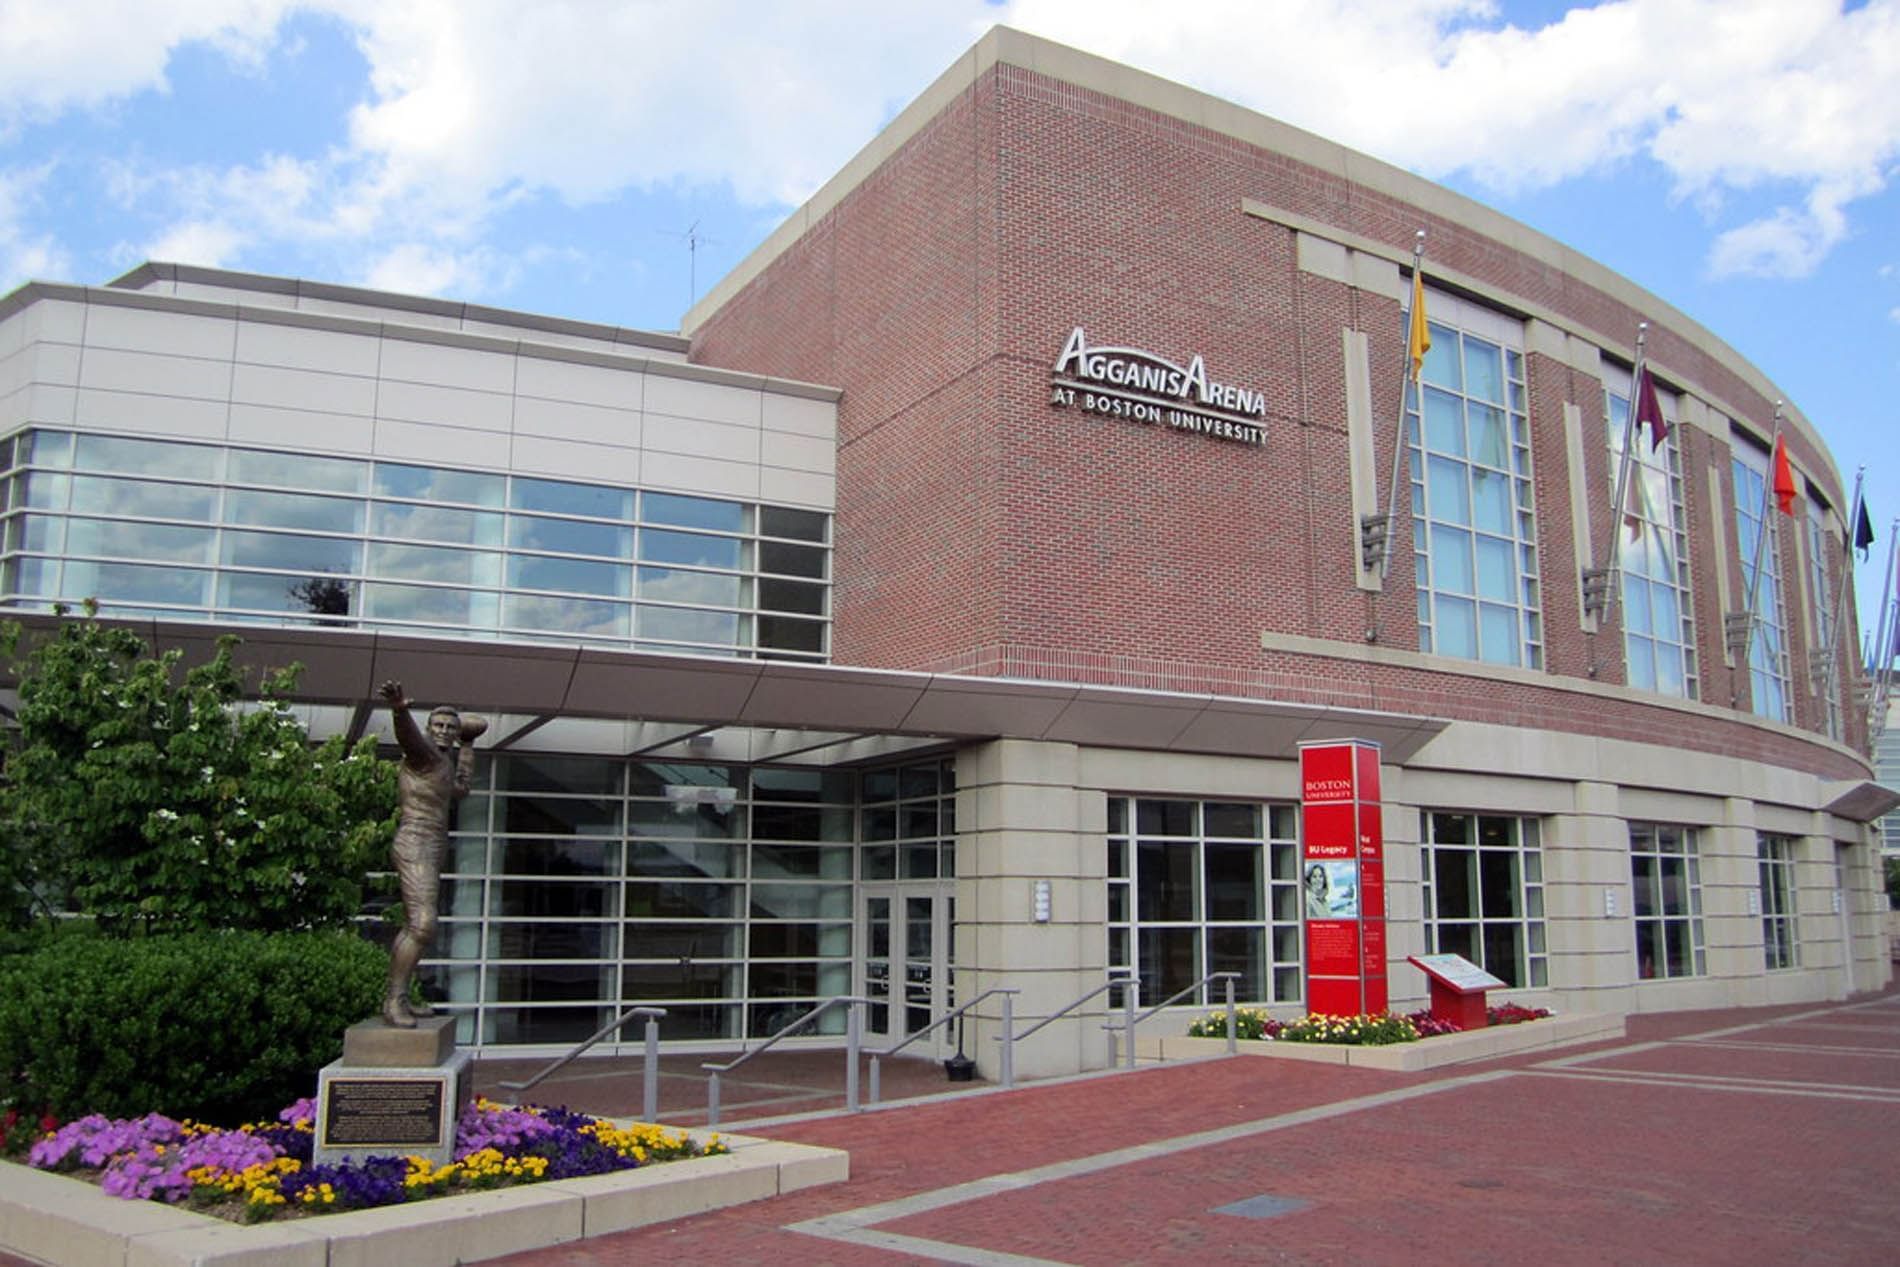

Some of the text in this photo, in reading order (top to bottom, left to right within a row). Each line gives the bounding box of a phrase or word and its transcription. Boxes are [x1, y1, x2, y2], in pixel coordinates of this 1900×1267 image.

[1055, 327, 1266, 416] AGGANIS ARENA
[1053, 388, 1269, 445] AT BOSTON UNIVERSITY
[1305, 780, 1351, 791] BOSTON
